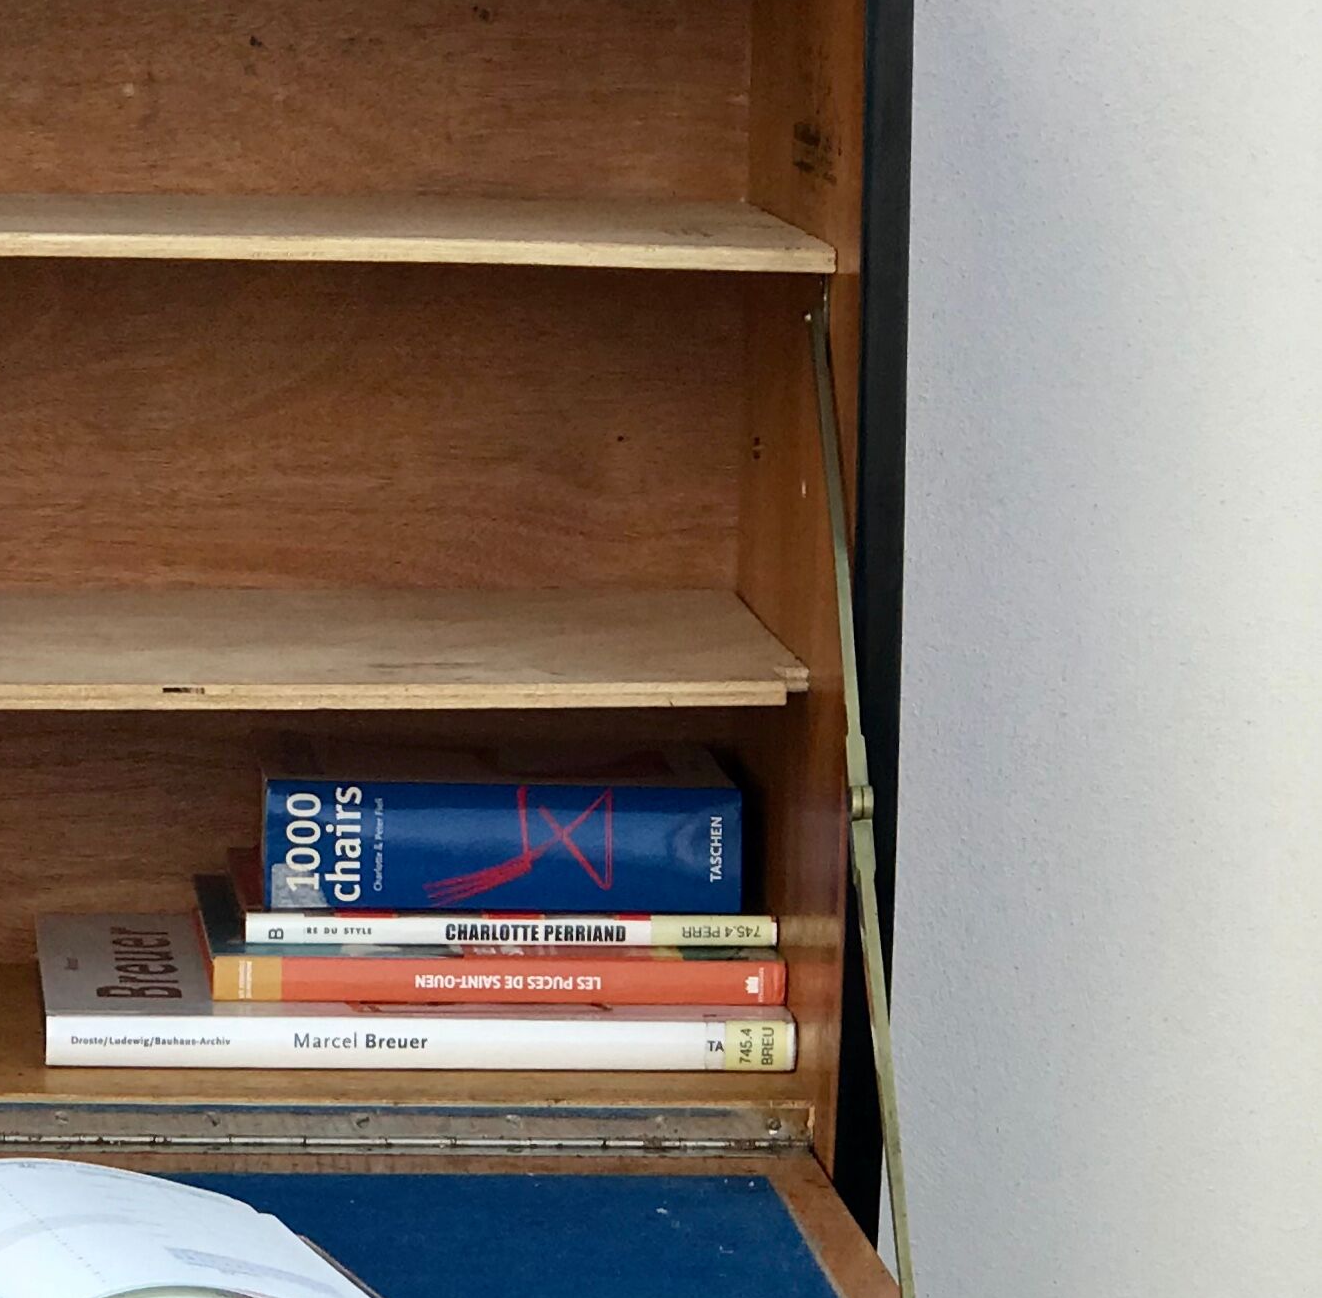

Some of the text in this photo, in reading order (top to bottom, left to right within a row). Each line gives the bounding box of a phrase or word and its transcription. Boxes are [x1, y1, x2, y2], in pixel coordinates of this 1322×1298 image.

[286, 793, 322, 892] 1000
[324, 786, 362, 902] chairs
[709, 816, 723, 883] TASCHEN
[323, 927, 338, 935] DU
[343, 927, 372, 936] STYLE
[445, 923, 627, 943] CHARLOTTE PERRIAND
[681, 925, 762, 939] 745.4 PERR
[96, 926, 183, 999] Breuer
[414, 974, 601, 990] LES PUCES DE SAINT-OUEN
[293, 1032, 428, 1049] Marcel Breuer
[738, 1028, 753, 1064] 745.4
[761, 1027, 775, 1066] BREU
